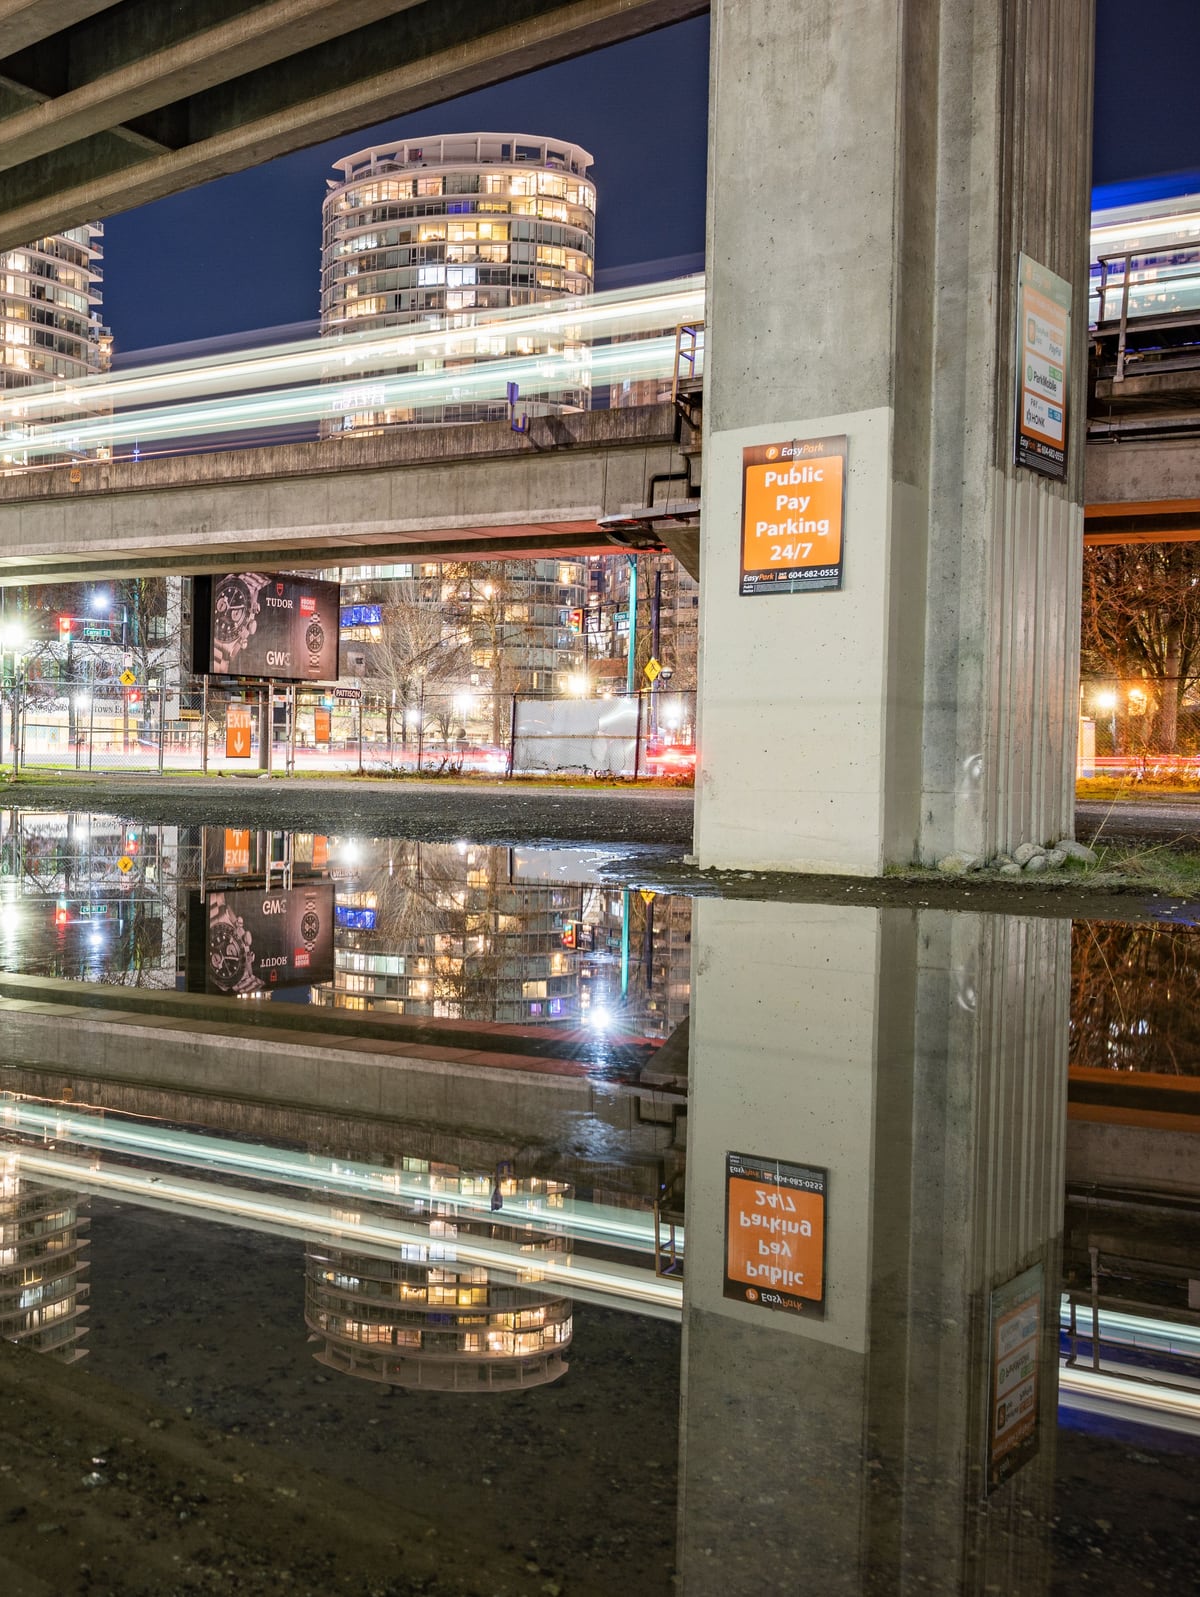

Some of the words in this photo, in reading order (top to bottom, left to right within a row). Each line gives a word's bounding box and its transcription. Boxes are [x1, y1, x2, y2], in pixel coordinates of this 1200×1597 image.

[781, 442, 824, 457] EasyPark
[764, 467, 823, 488] Public
[776, 495, 810, 512] Pay
[756, 518, 830, 538] Parking
[770, 543, 813, 561] 24/7
[743, 572, 774, 583] EasyPark
[788, 568, 839, 579] 604-682-0555
[266, 597, 293, 609] TUDOR
[227, 712, 251, 728] EXIT
